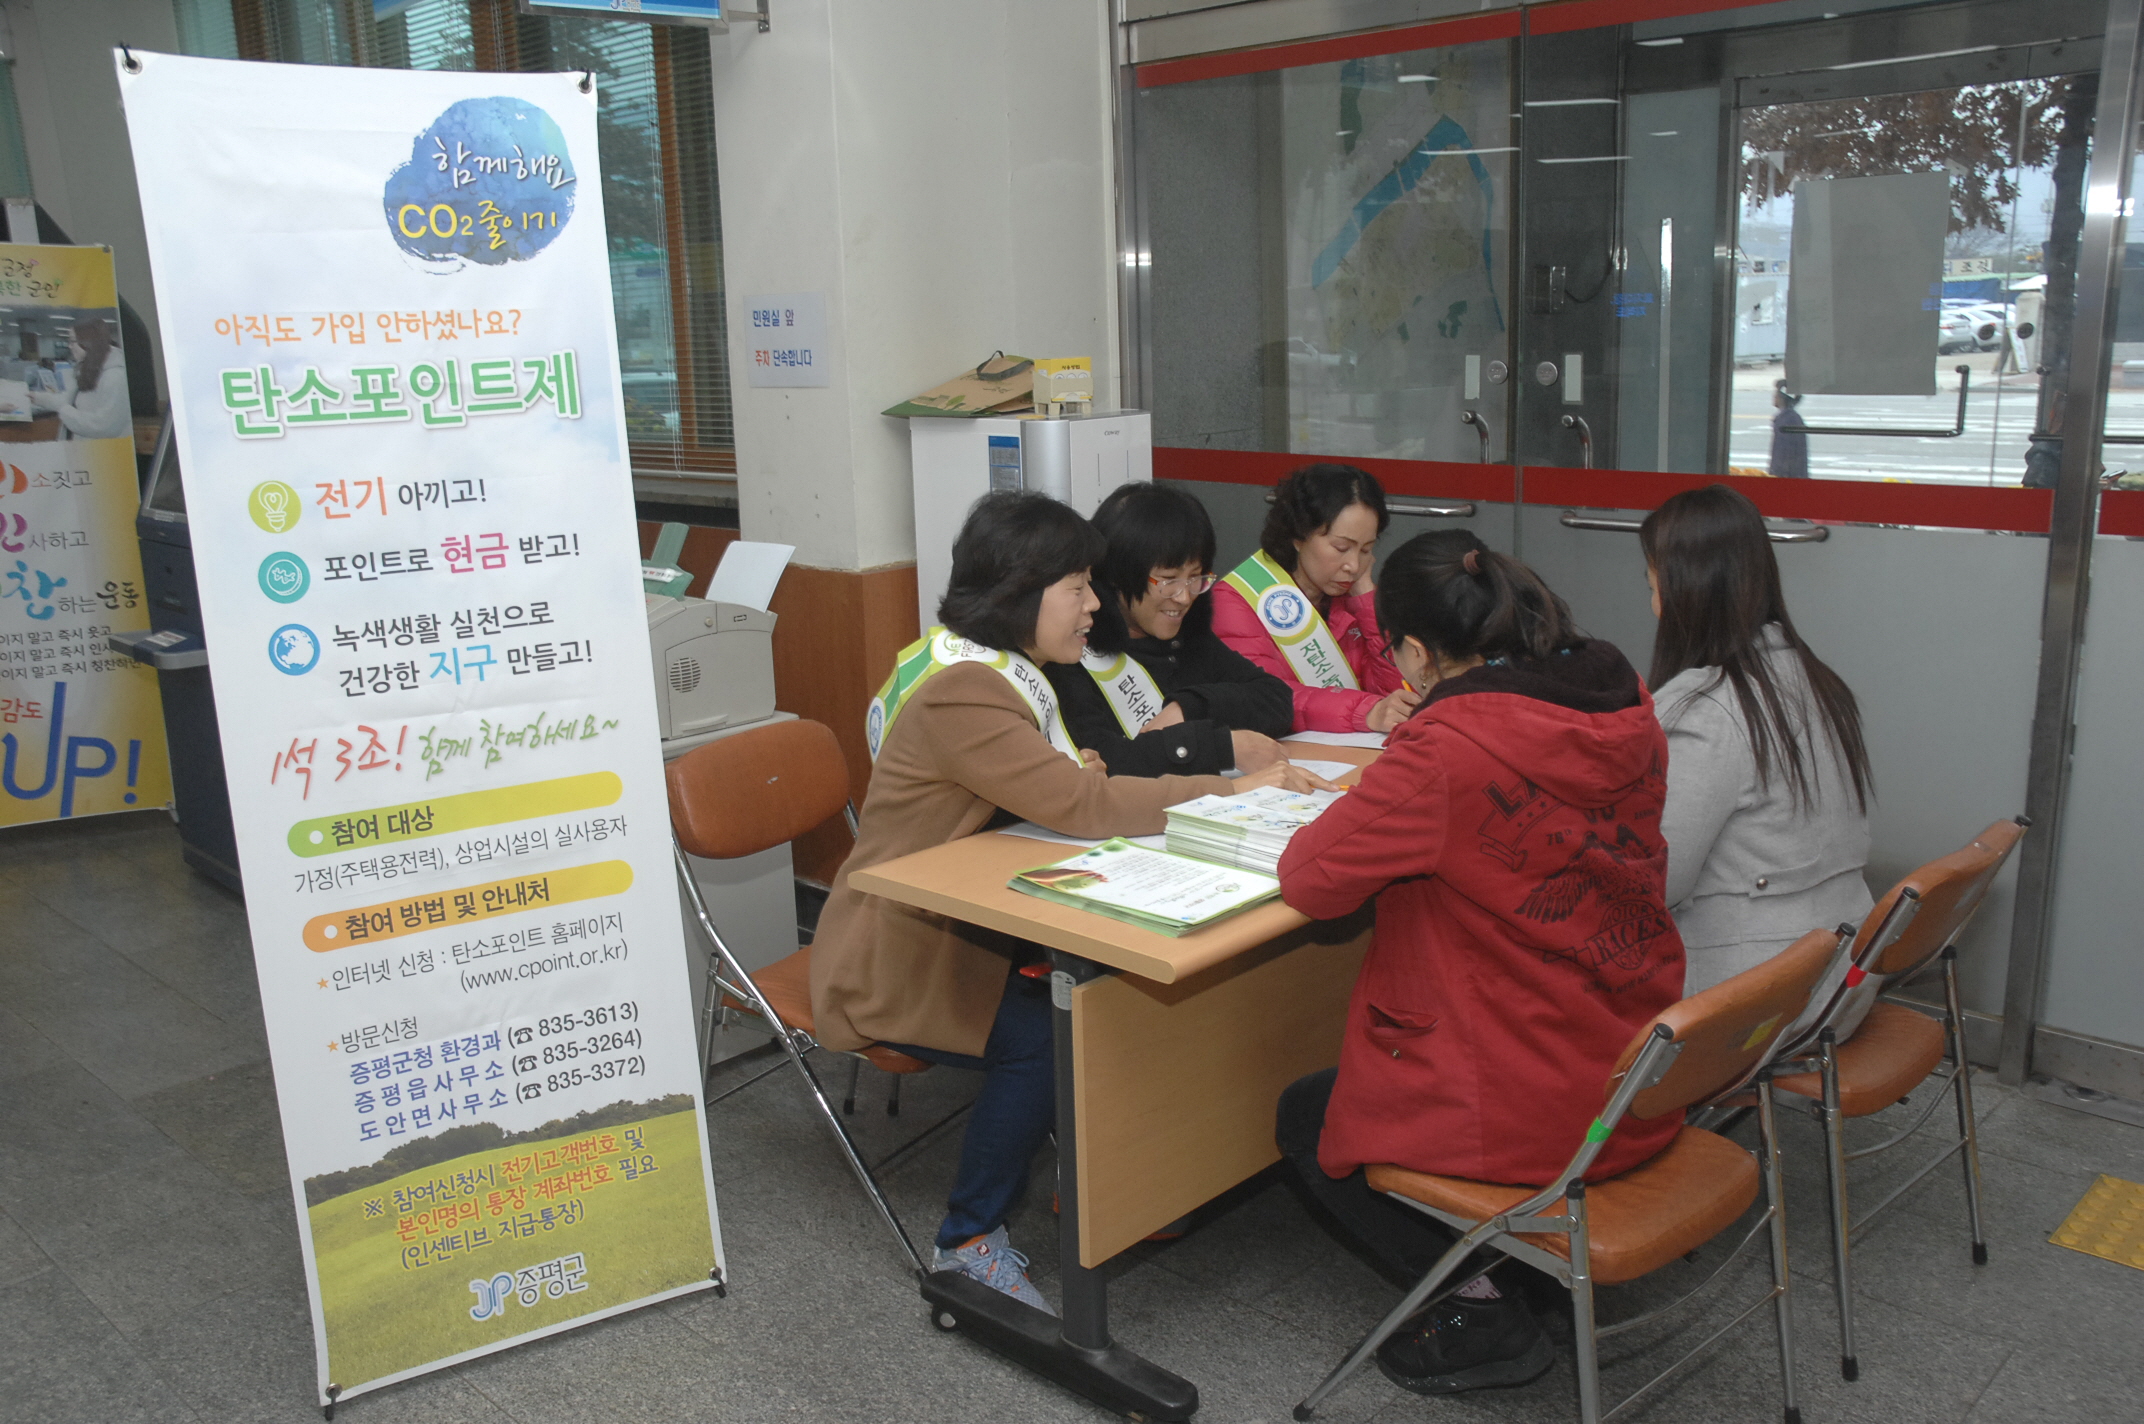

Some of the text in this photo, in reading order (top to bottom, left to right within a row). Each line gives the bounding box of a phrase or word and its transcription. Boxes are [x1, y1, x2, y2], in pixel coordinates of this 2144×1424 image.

[432, 136, 575, 190] 함께해요
[478, 200, 557, 250] 줄이기
[214, 308, 522, 347] 아직도 가입 안하셨나요?
[753, 309, 795, 328] 민원실 앞
[773, 349, 813, 367] 단속합니다
[220, 350, 581, 437] 탄소포인트제
[314, 476, 487, 520] 전기 아끼고!
[323, 532, 580, 582] 포인트로 현금 받고!
[96, 580, 140, 610] 운동
[332, 601, 554, 652] 녹색생활 실천으로
[339, 640, 593, 698] 건강한 지구 만들고!
[1, 681, 142, 818] UP!
[418, 725, 472, 782] 함께
[330, 805, 435, 847] 참여 대상
[454, 827, 549, 866] 상업시설의
[554, 814, 628, 848] 실사용자
[344, 877, 551, 940] 참여 방법 및 안내처
[332, 961, 392, 992] 인터넷
[398, 949, 435, 978] 신청
[452, 927, 546, 966] 탄소포인트
[551, 911, 624, 945] 홈페이지
[460, 938, 629, 993] (www.cpoint.or.kr)
[341, 1016, 419, 1054] 방문신청
[350, 1044, 434, 1086] 증평군청
[440, 1030, 502, 1064] 환경과
[391, 1163, 497, 1211] 참여신청시
[501, 1133, 620, 1183] 전기고객번호
[623, 1126, 646, 1151] 및
[395, 1153, 659, 1242] 본인명의 통장 계좌번호 필요
[401, 1198, 585, 1270] (인센티브 지급통장)
[517, 1253, 589, 1306] 증평군
